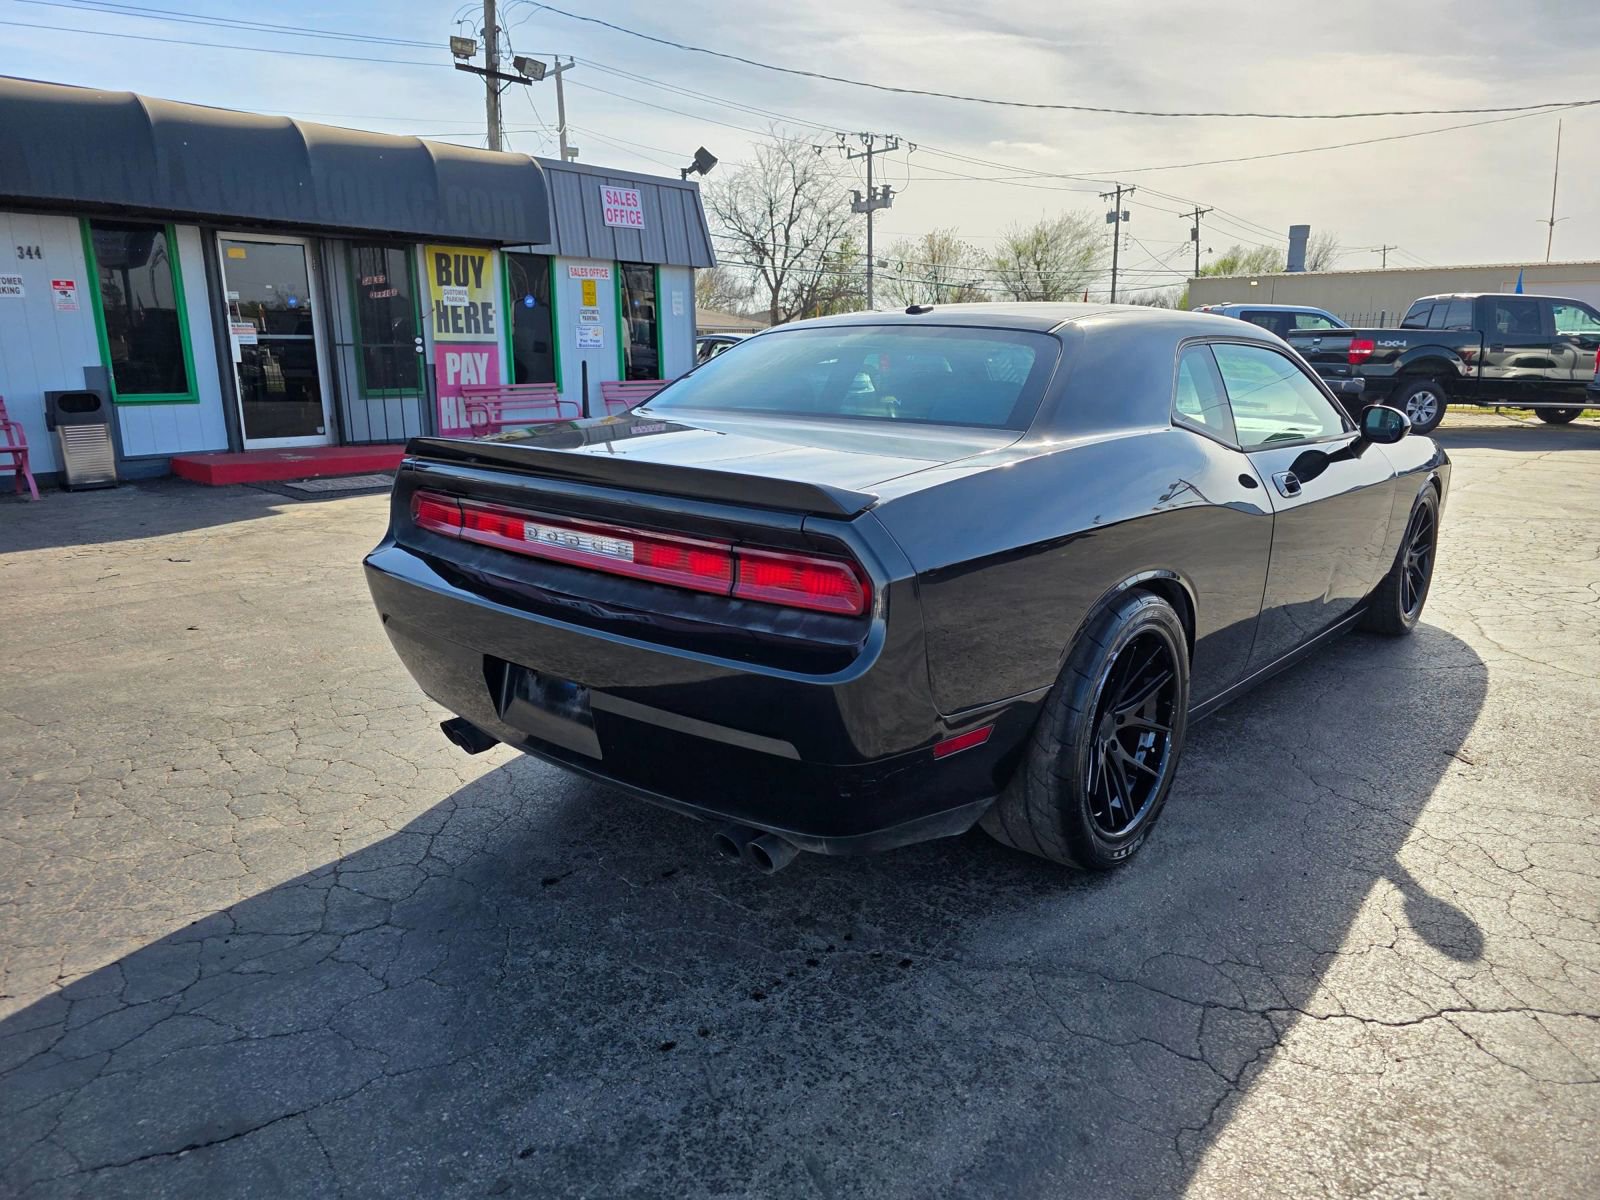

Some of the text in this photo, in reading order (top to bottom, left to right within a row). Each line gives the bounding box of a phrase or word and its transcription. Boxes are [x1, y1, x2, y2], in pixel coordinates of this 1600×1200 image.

[606, 190, 638, 208] SALES
[606, 208, 642, 225] OFFICE
[16, 245, 42, 260] 344
[435, 252, 485, 289] BUY
[570, 267, 609, 278] SALES OFFICE
[435, 300, 495, 335] HERE
[445, 352, 489, 385] PAY
[527, 526, 630, 557] DODGE
